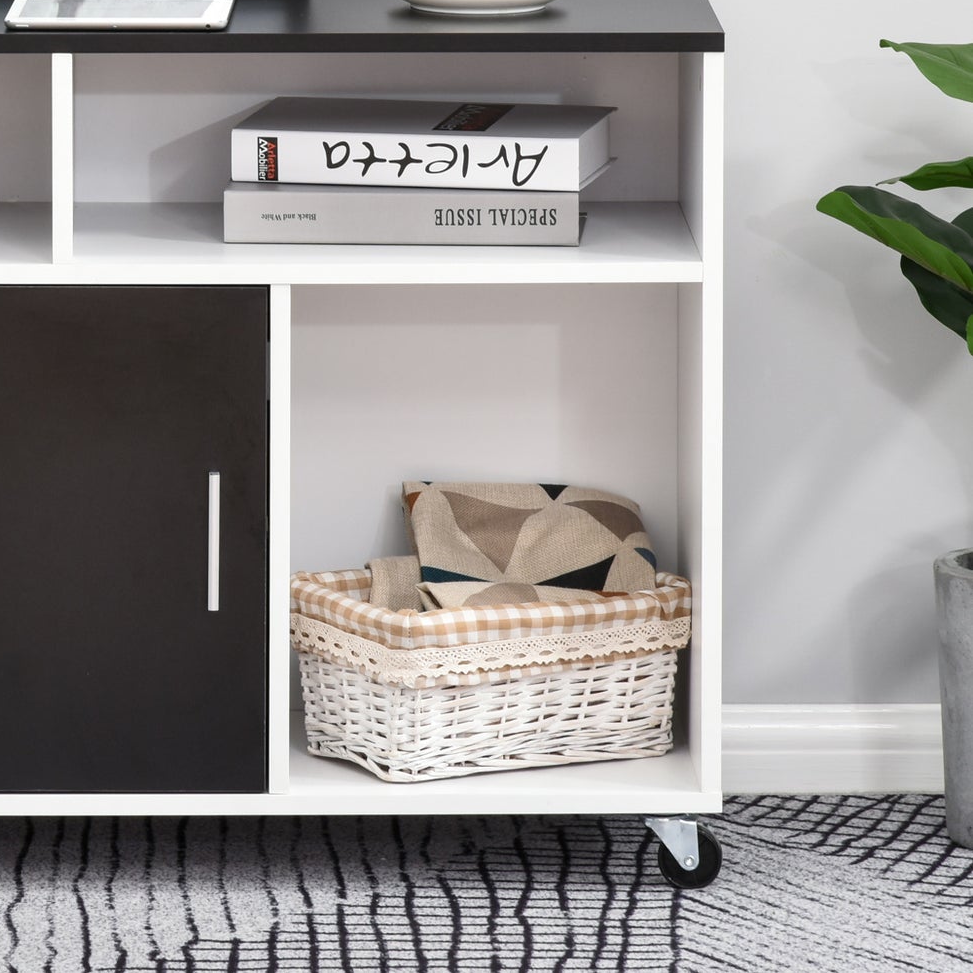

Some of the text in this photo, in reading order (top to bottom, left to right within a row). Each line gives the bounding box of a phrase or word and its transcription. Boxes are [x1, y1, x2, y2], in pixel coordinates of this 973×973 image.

[258, 138, 268, 181] Mobilier
[267, 141, 276, 179] Arletta
[323, 140, 549, 187] Arletta
[260, 213, 317, 221] Black and White
[434, 208, 557, 226] SPECIAL ISSUE
